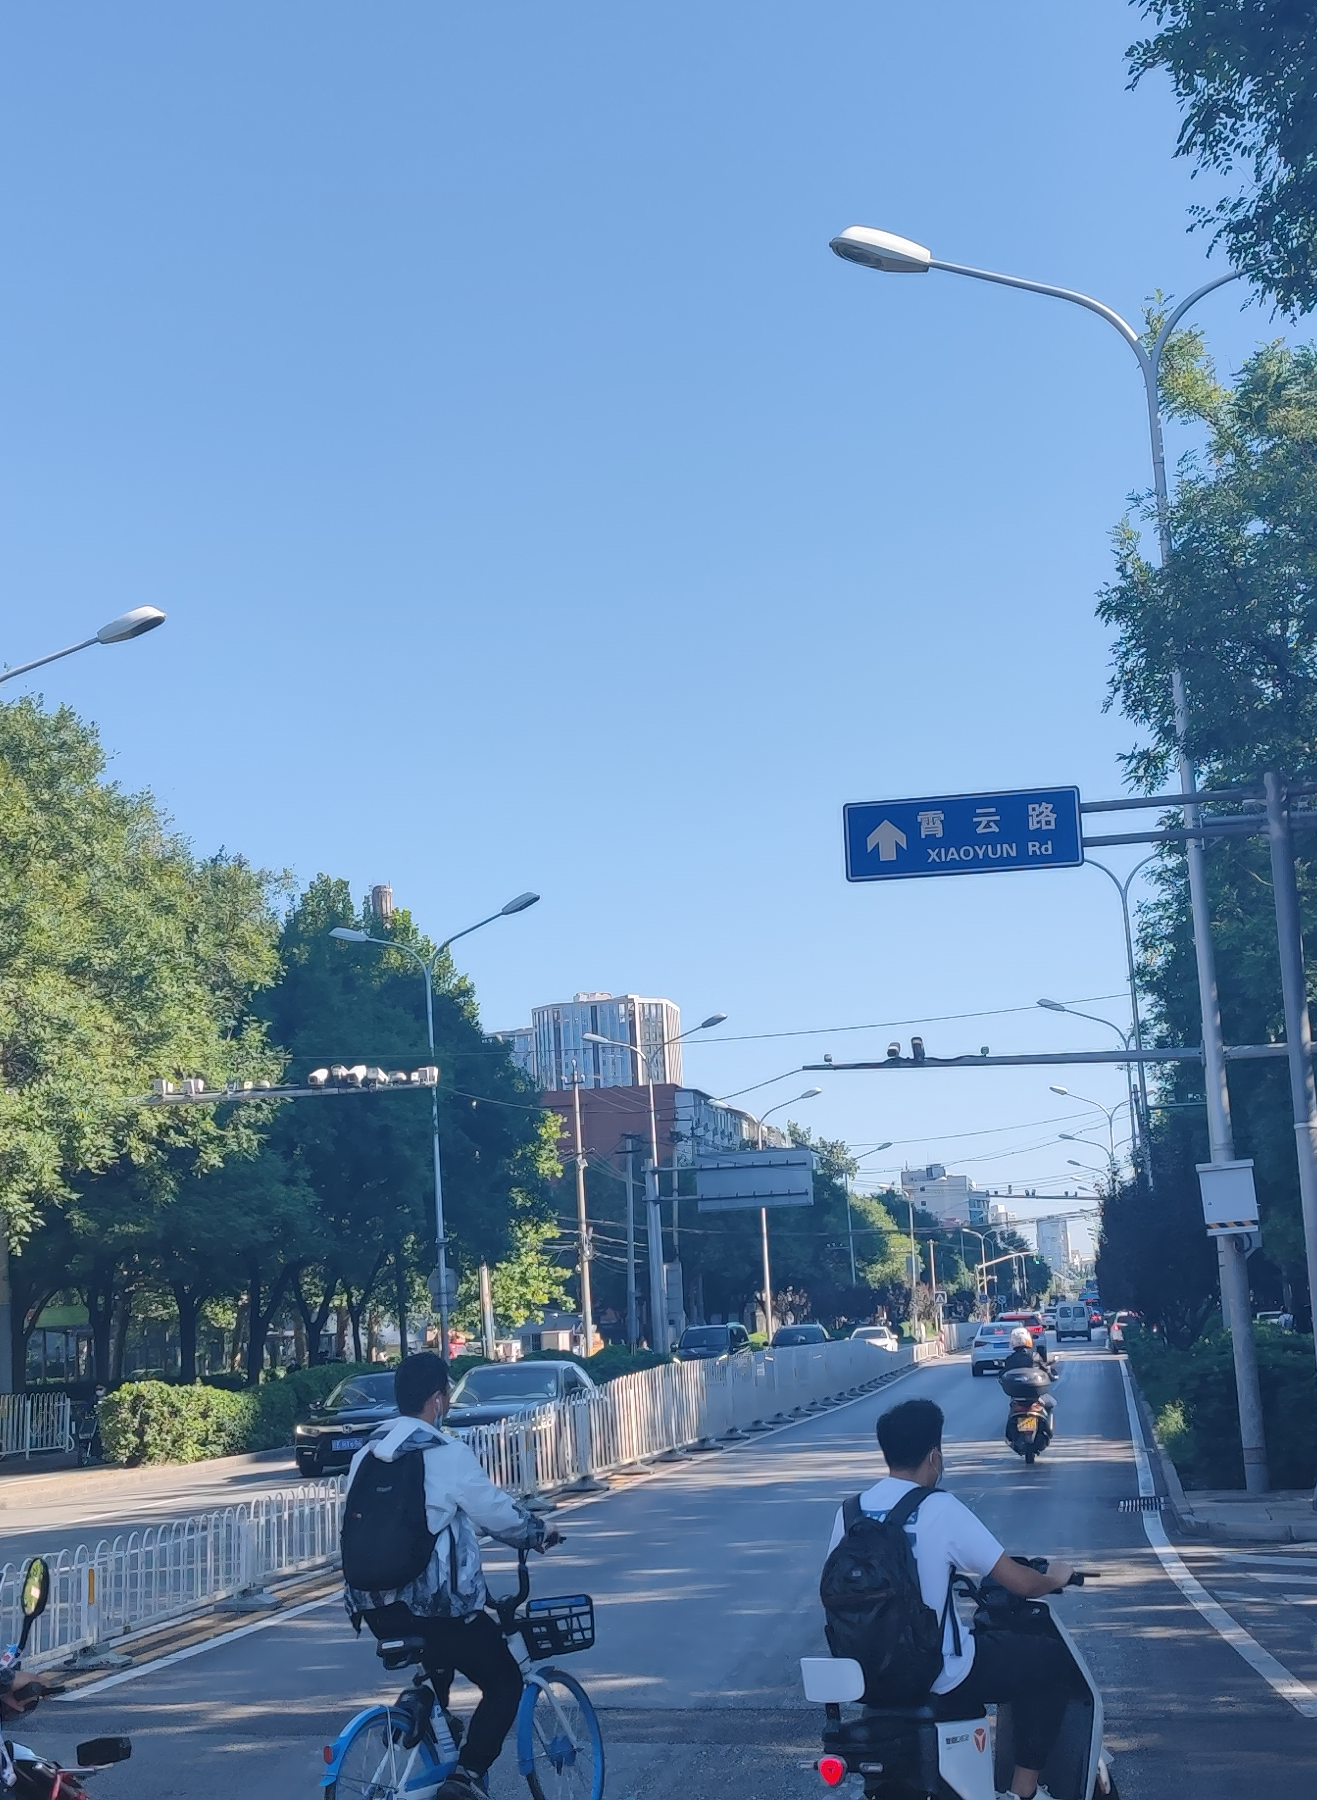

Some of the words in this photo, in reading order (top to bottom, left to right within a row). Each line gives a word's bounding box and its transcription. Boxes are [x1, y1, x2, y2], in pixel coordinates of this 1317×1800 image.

[917, 802, 1057, 838] 霄云路
[927, 843, 1017, 863] XIAOYUN
[1028, 840, 1053, 856] Rd
